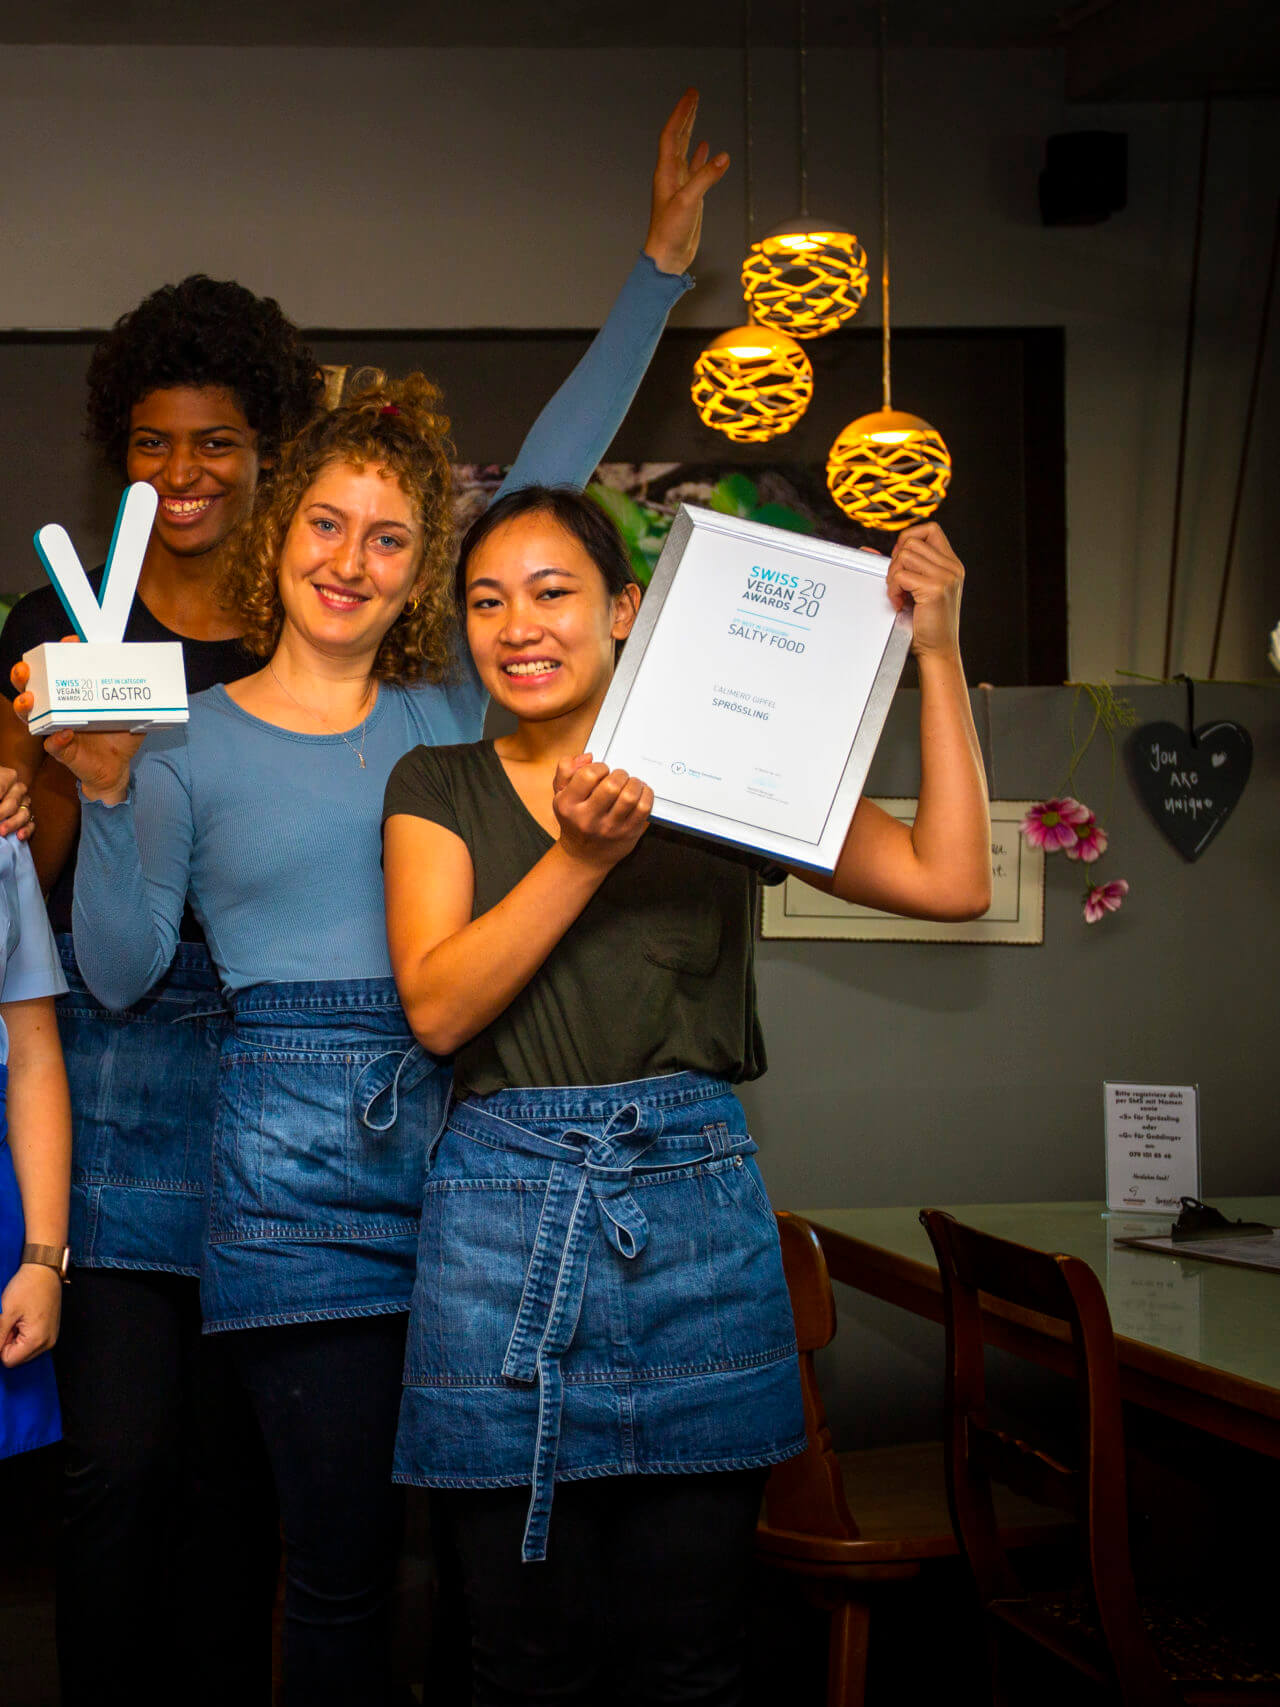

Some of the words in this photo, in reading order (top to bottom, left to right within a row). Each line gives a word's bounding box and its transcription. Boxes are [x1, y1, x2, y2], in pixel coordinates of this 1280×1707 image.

[750, 565, 800, 588] SWISS
[747, 578, 795, 601] VEGAN
[800, 579, 826, 600] 20
[742, 591, 791, 611] AWARDS
[792, 596, 820, 618] 20
[728, 623, 768, 643] SALTY
[769, 635, 806, 654] FOOD
[55, 679, 79, 687] SWISS
[56, 687, 80, 695] VEGAN
[102, 686, 152, 701] GASTRO
